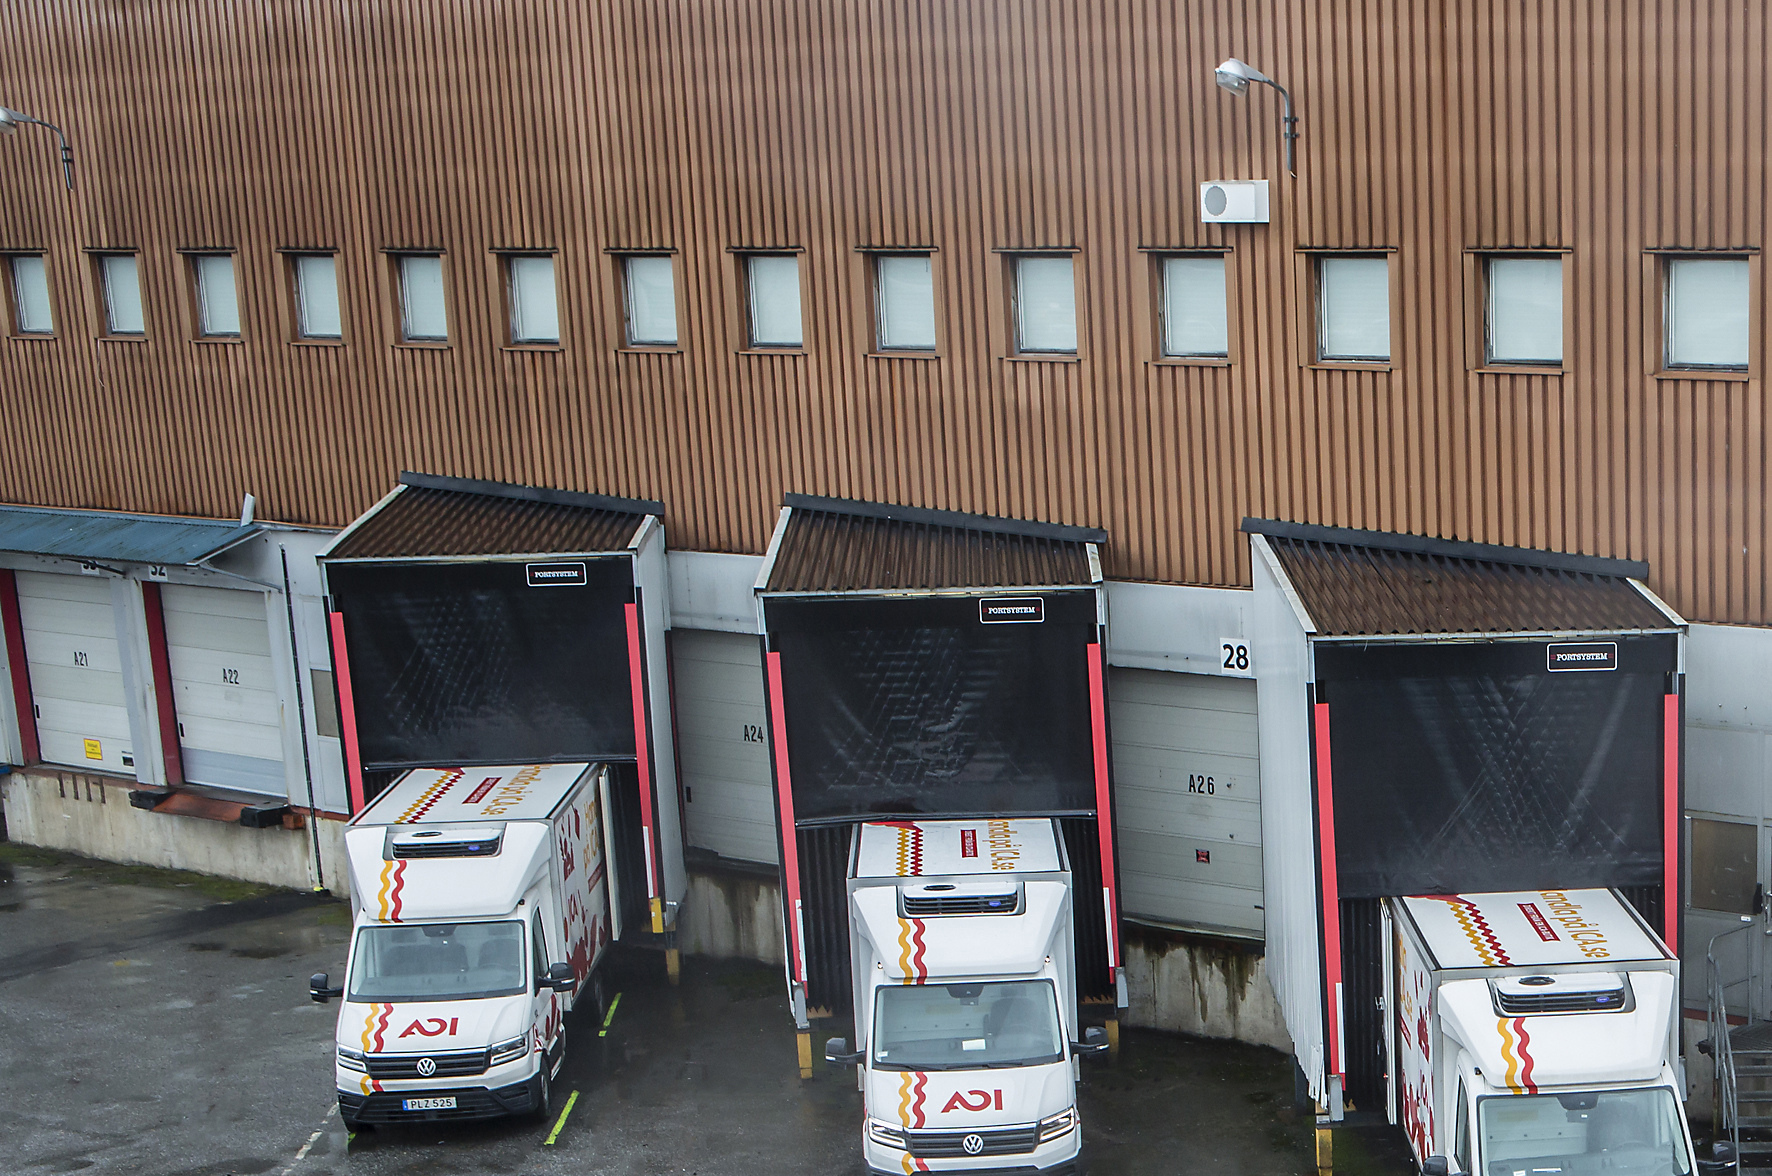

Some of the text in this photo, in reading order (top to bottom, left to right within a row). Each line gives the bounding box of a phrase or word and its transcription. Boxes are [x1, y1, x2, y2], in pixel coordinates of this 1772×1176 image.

[988, 606, 1036, 614] PORTSYSTEM
[73, 651, 89, 667] A21
[1222, 643, 1250, 671] 28
[1556, 652, 1608, 662] PORTSYSTEM
[222, 668, 240, 685] A22
[744, 724, 764, 743] A24
[1188, 774, 1215, 796] A26
[1539, 890, 1610, 958] andla på ICA.se
[411, 1098, 453, 1109] PLZ 525
